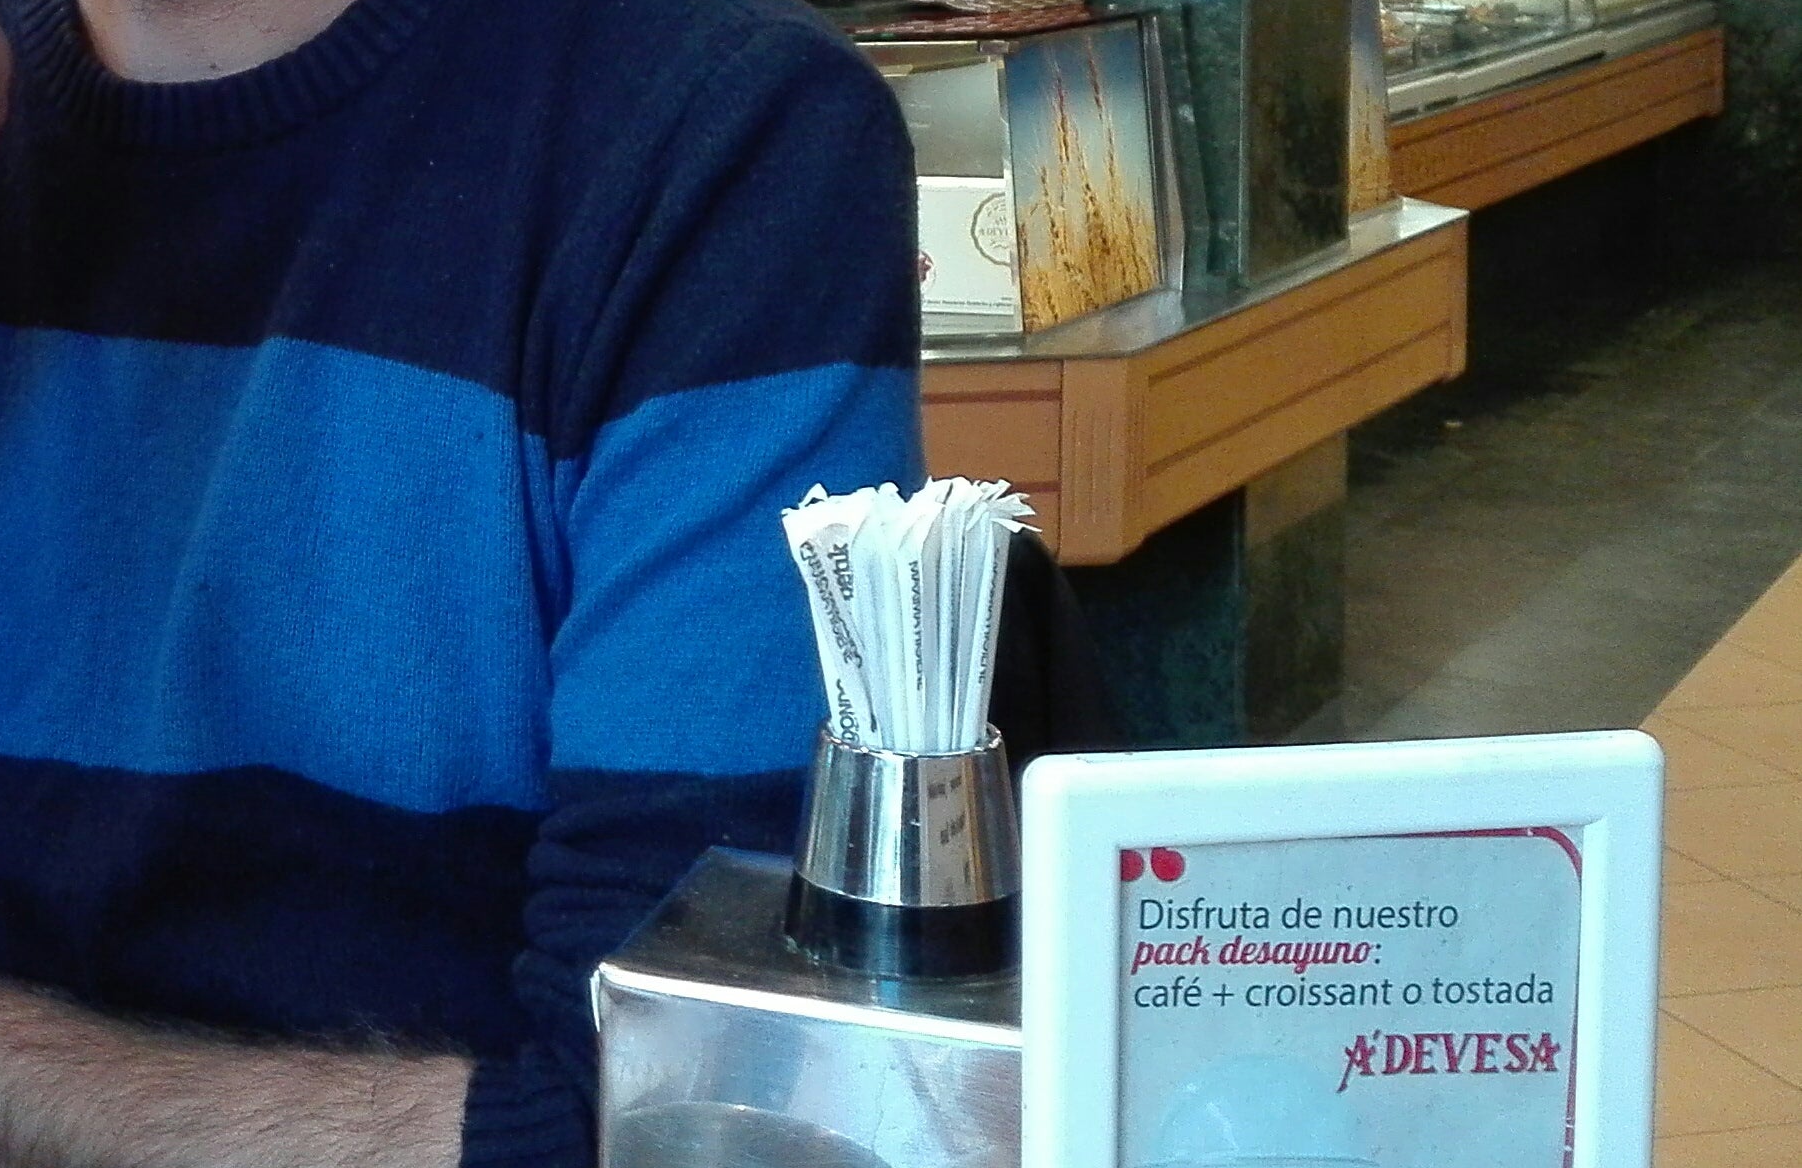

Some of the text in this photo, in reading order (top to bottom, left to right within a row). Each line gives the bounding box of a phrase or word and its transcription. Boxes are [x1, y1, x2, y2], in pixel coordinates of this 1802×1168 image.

[1138, 898, 1459, 930] Disfruta de nuestro
[1130, 935, 1382, 976] pack desayuno:
[1134, 973, 1554, 1008] café + croissant o tostada
[1334, 1029, 1562, 1095] A'DEVESA
